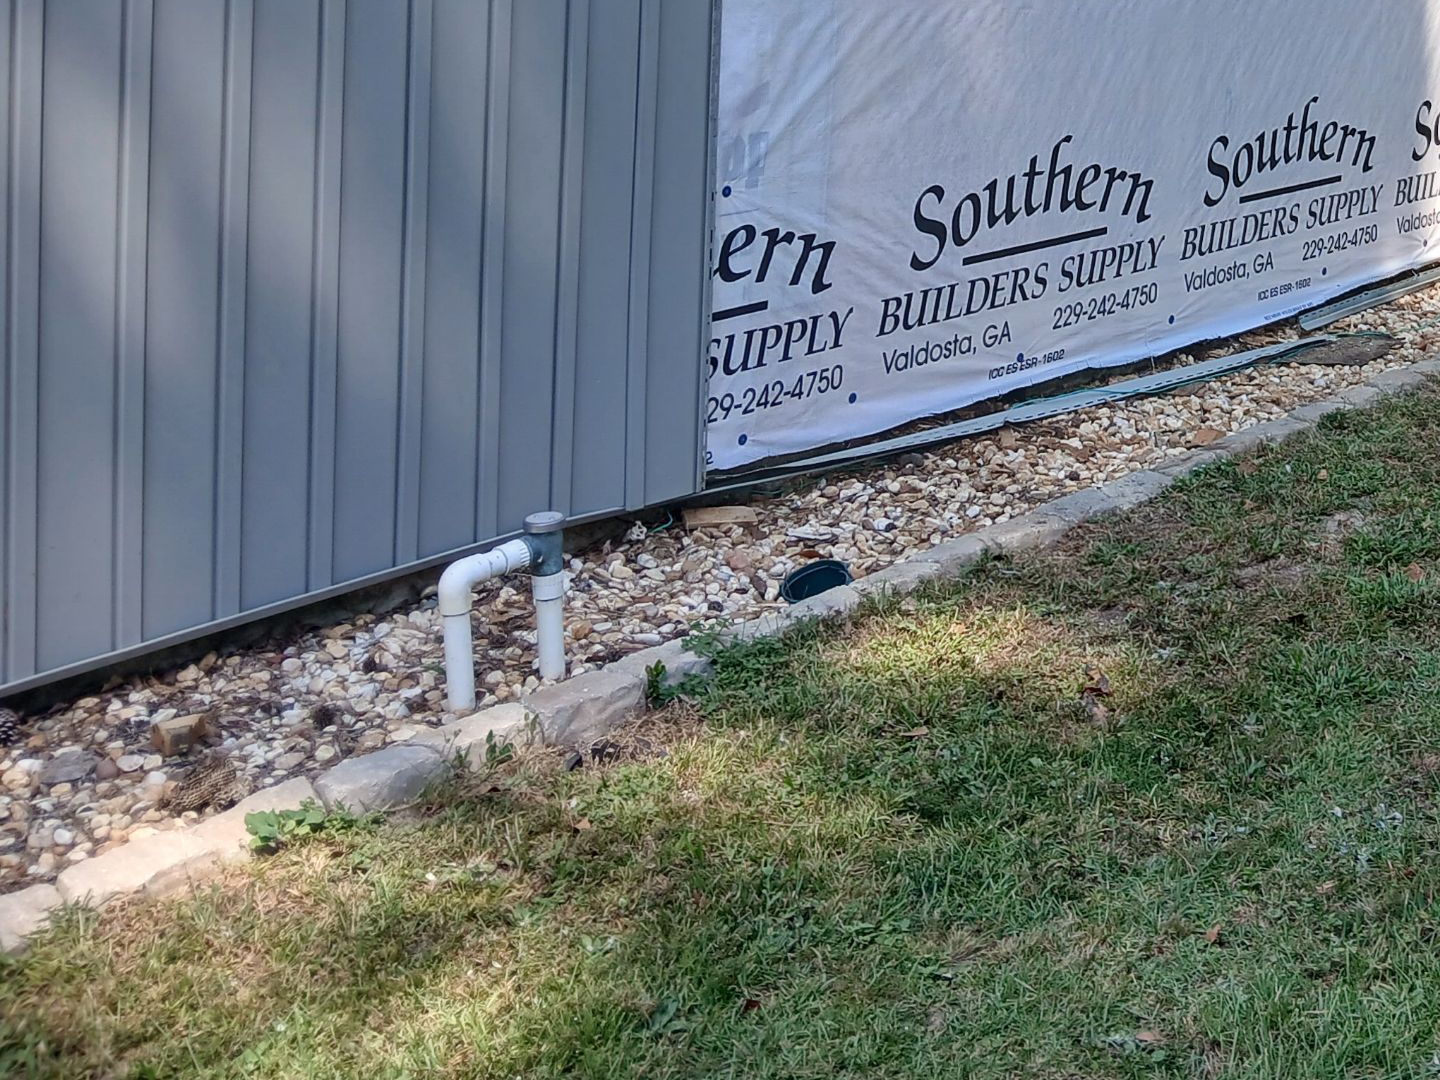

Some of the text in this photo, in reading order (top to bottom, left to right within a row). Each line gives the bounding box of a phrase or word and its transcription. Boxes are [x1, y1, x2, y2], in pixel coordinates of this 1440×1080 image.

[1202, 95, 1376, 209] Southern
[909, 134, 1155, 272] Southern
[1179, 183, 1383, 261] BUILDERS SUPPLY
[713, 223, 837, 295] ern
[1184, 251, 1274, 293] Valdosta, GA
[1302, 224, 1378, 261] 229-242-4750
[875, 234, 1166, 338] BUILDERS SUPPLY
[1052, 282, 1158, 330] 229-242-4750
[707, 306, 854, 379] SUPPLY
[882, 321, 1011, 375] Valdosta, GA
[988, 366, 1004, 380] ICC
[1006, 362, 1020, 375] ES
